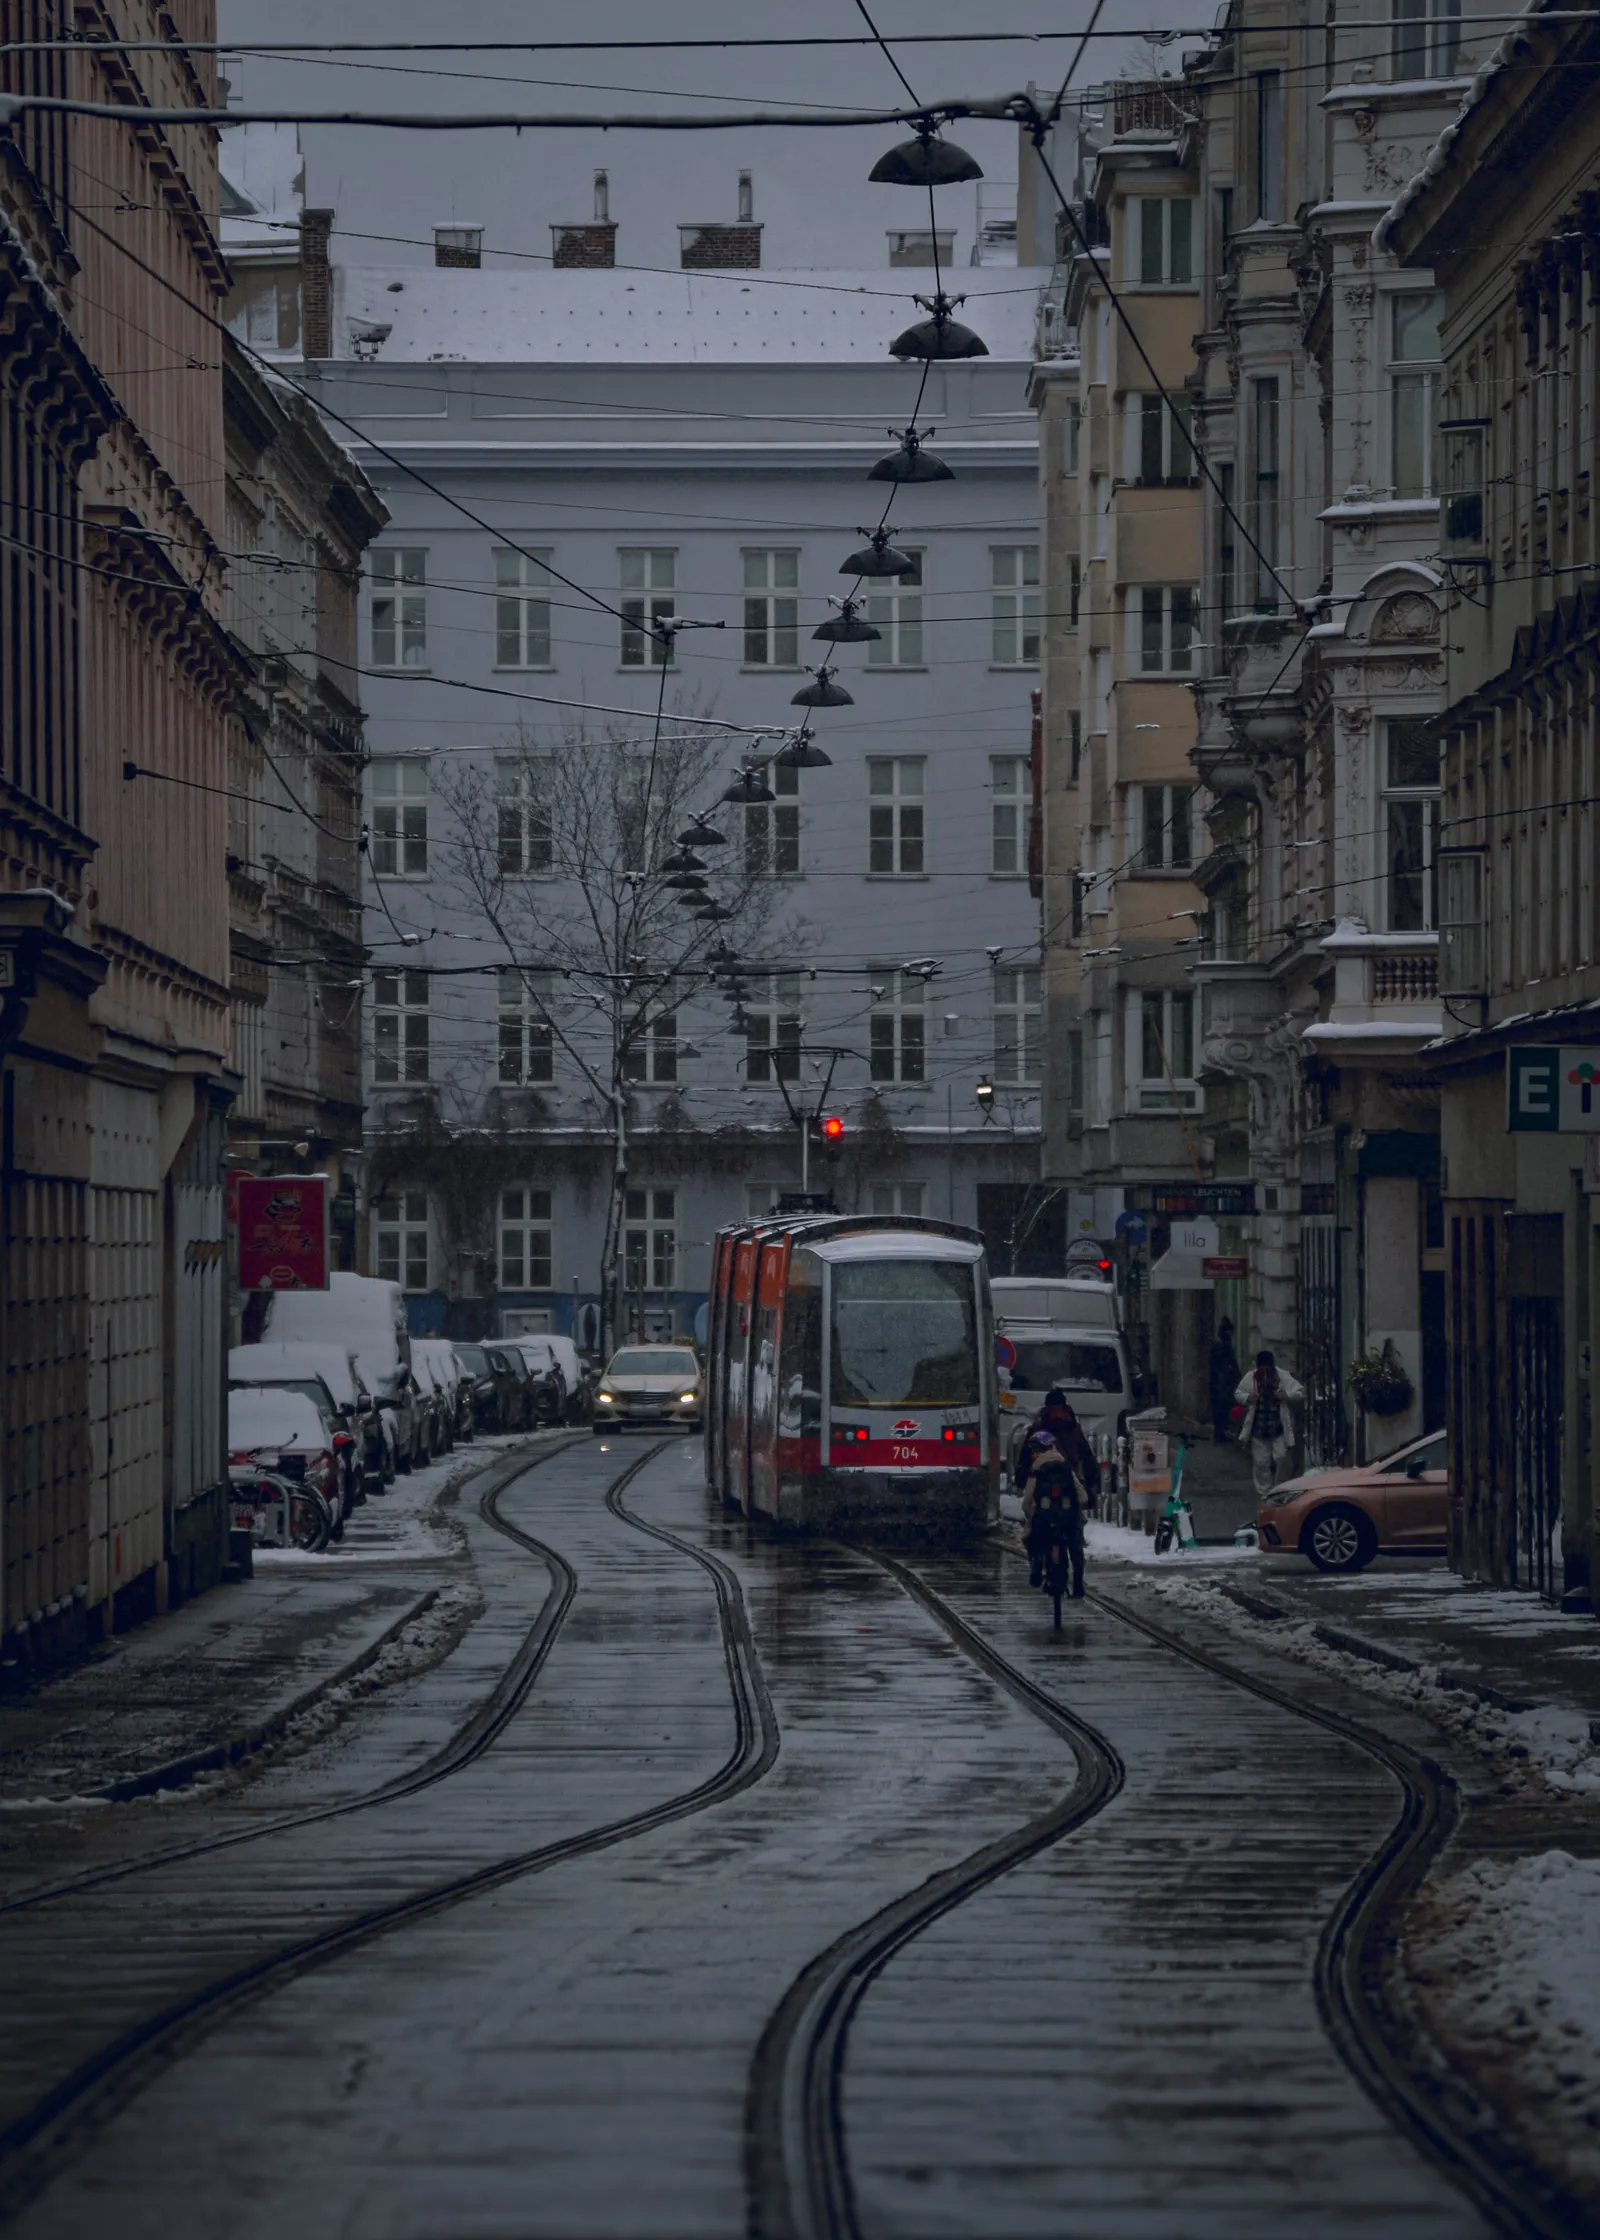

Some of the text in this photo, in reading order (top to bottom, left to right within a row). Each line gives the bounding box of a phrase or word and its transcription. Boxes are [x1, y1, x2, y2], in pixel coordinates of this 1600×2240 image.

[1518, 1066, 1551, 1113] E
[1184, 1231, 1206, 1248] lila
[892, 1446, 919, 1460] 704
